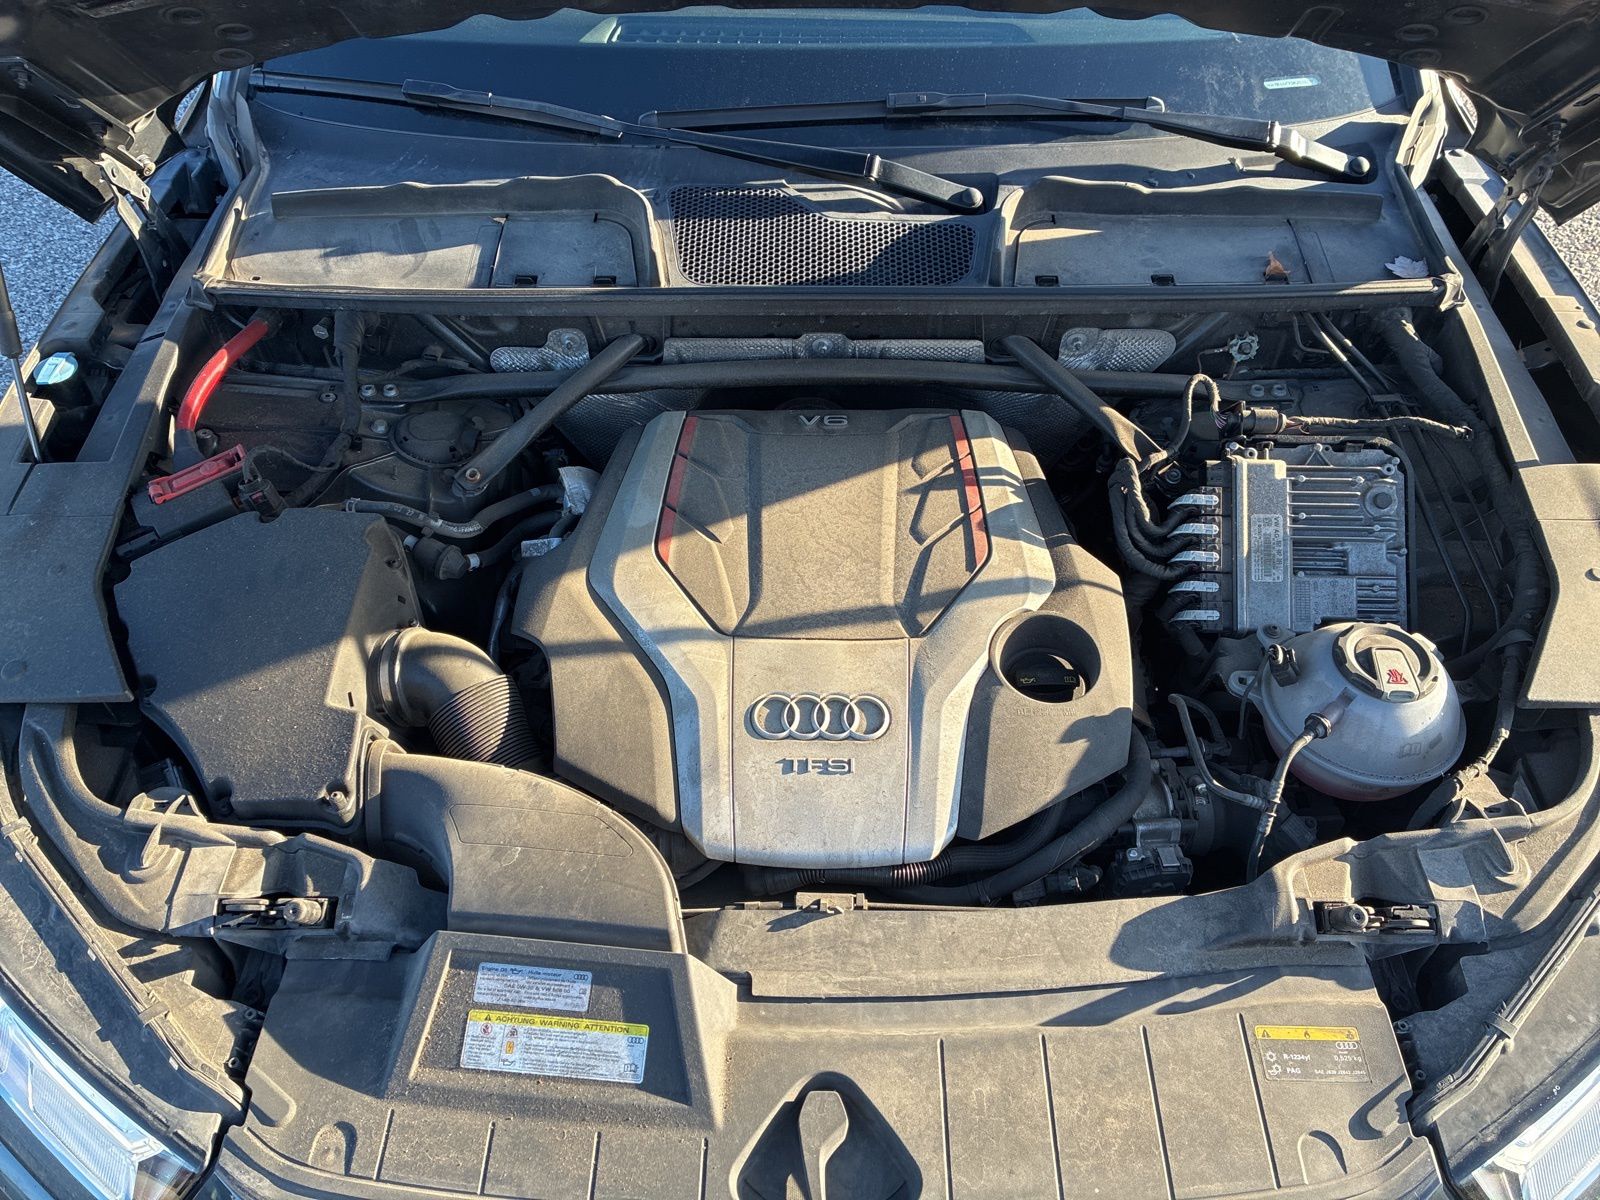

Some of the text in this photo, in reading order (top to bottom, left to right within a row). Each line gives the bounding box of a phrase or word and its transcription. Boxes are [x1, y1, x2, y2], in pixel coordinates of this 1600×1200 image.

[799, 415, 848, 426] V6
[778, 757, 855, 774] TFSI
[539, 1019, 580, 1030] WARNING
[584, 1022, 630, 1034] ATTENTION
